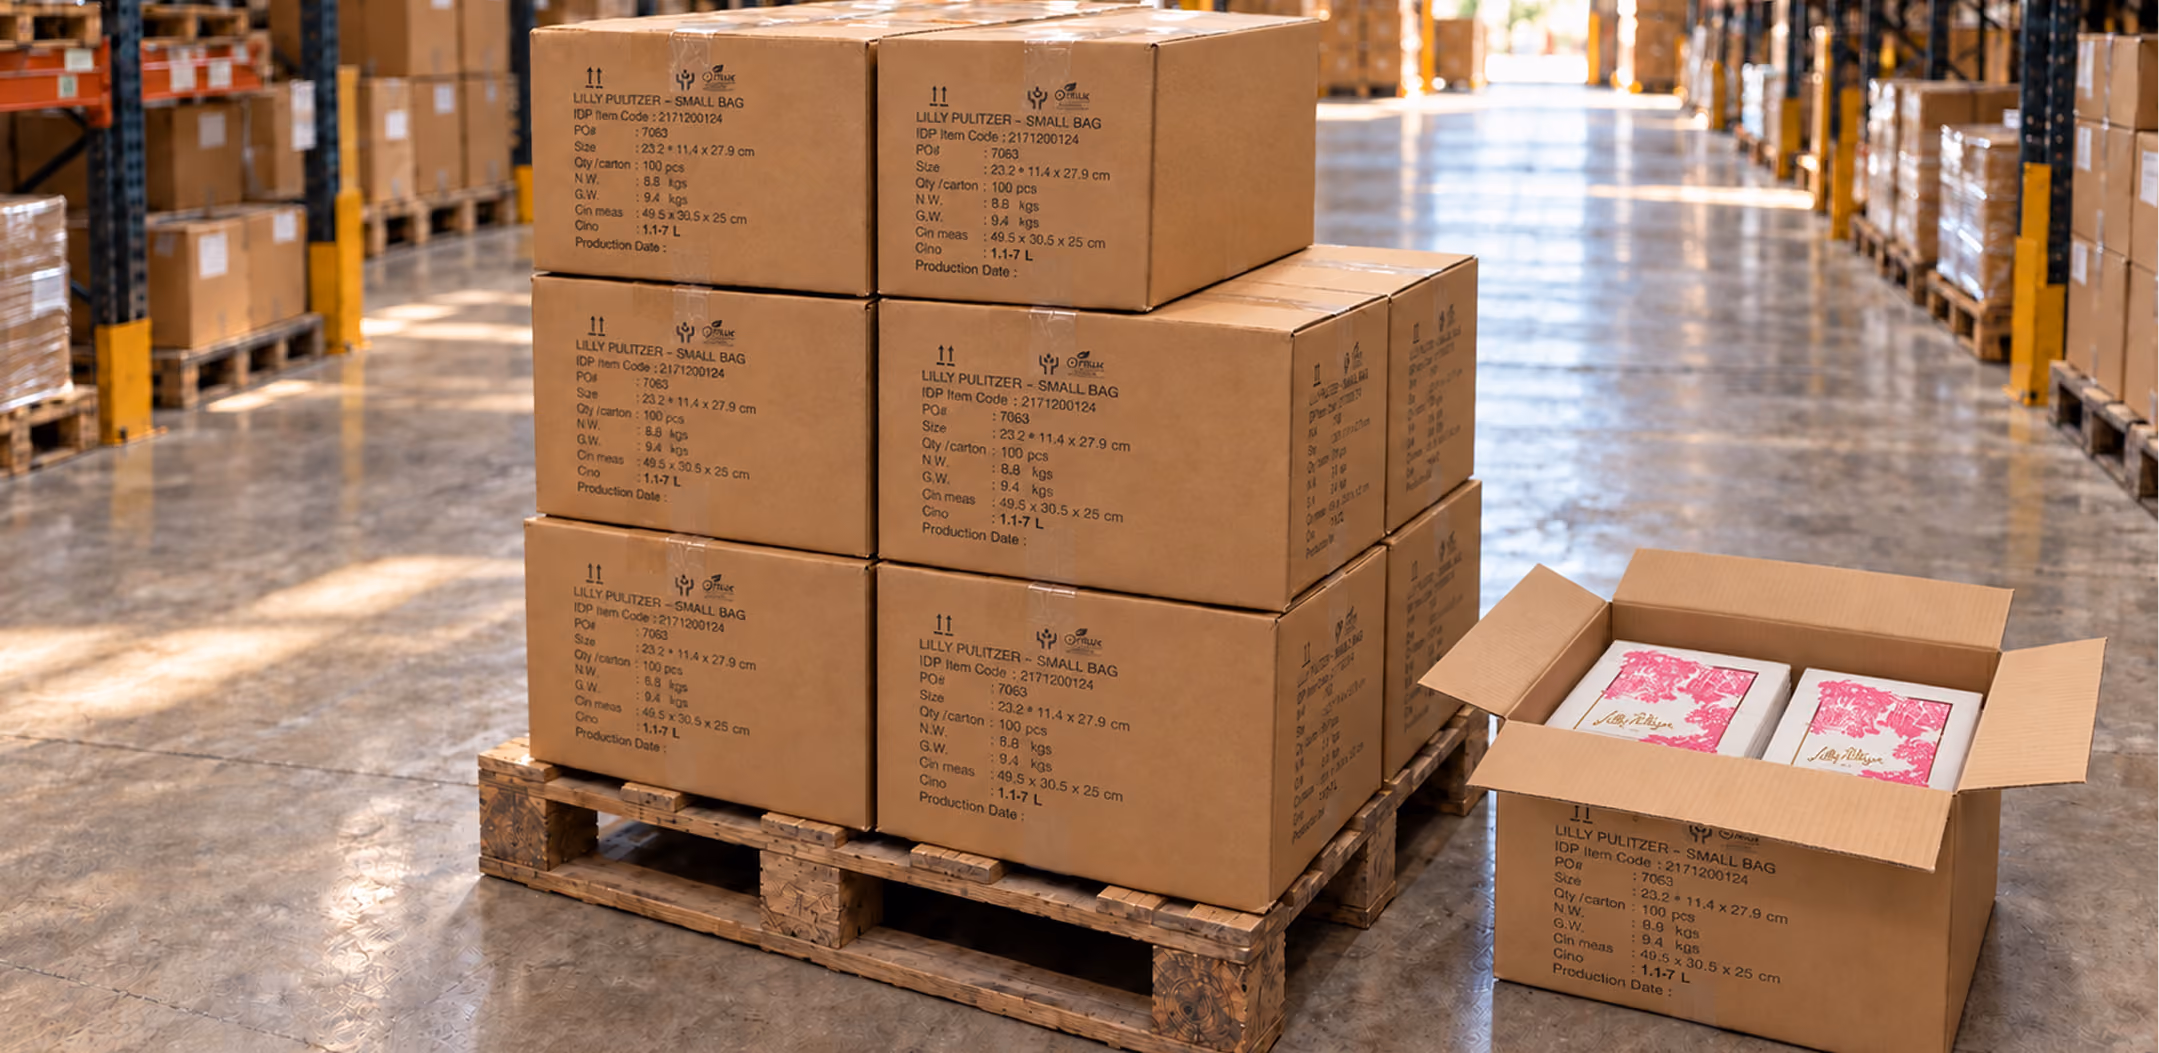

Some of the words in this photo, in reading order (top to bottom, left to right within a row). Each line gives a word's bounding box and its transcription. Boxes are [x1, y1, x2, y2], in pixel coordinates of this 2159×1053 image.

[573, 92, 603, 104] LILLY
[674, 95, 714, 108] SMALL
[718, 96, 744, 109] BAG
[658, 111, 723, 124] 2171200124
[916, 111, 949, 123] LILLY
[951, 111, 1012, 126] PULITZER
[1025, 114, 1069, 128] SMALL
[1072, 116, 1101, 130] BAG
[641, 126, 668, 138] 7063
[916, 127, 937, 139] IDP
[967, 129, 999, 142] Code
[1008, 131, 1079, 145] 2171200124
[991, 147, 1019, 160] 7063
[643, 159, 662, 172] 100
[1028, 166, 1050, 177] 11.4
[1063, 167, 1089, 180] 27.9
[1091, 171, 1110, 181] cm
[992, 181, 1013, 194] 100
[1016, 184, 1037, 195] pcs
[1018, 200, 1039, 214] kgs
[575, 236, 632, 250] Production
[634, 240, 660, 253] Date
[937, 230, 968, 240] meas
[1029, 233, 1054, 246] 30.5
[1068, 235, 1083, 248] 25
[1087, 239, 1105, 249] cm
[915, 258, 978, 275] Production
[982, 264, 1010, 278] Date
[575, 339, 605, 352] LILLY
[608, 341, 663, 357] PULITZER
[676, 347, 716, 362] SMALL
[719, 351, 746, 365] BAG
[659, 362, 725, 378] 2171200124
[643, 377, 669, 390] 7063
[921, 369, 955, 383] LILLY
[958, 372, 1022, 389] PULITZER
[1038, 379, 1086, 395] SMALL
[1088, 384, 1118, 398] BAG
[922, 386, 944, 399] IDP
[975, 391, 1008, 406] Code
[1021, 395, 1096, 413] 2171200124
[1000, 410, 1030, 424] 7063
[922, 419, 946, 433] Size
[1040, 432, 1064, 445] 11.4
[1079, 435, 1107, 450] 27.9
[1111, 441, 1130, 452] cm
[1001, 446, 1023, 459] 100
[1027, 451, 1048, 463] pcs
[1032, 465, 1053, 482] kgs
[577, 480, 633, 498] Production
[636, 488, 660, 502] Date
[1031, 483, 1053, 499] kgs
[944, 493, 976, 505] meas
[1040, 502, 1068, 516] 30.5
[1083, 507, 1100, 520] 25
[1104, 512, 1123, 523] cm
[922, 521, 986, 541] Production
[990, 530, 1019, 545] Date
[573, 586, 603, 599] LILLY
[605, 589, 661, 608] PULITZER
[674, 600, 715, 616] SMALL
[718, 606, 746, 620] BAG
[658, 614, 724, 632] 2171200124
[642, 626, 668, 640] 7063
[643, 660, 661, 673] 100
[919, 638, 953, 653] LILLY
[956, 642, 1021, 663] PULITZER
[1036, 654, 1083, 673] SMALL
[1087, 661, 1118, 677] BAG
[919, 654, 942, 668] IDP
[974, 662, 1006, 678] Code
[1020, 669, 1093, 690] 2171200124
[998, 682, 1028, 698] 7063
[919, 688, 944, 703] Size
[1038, 706, 1062, 720] 11.4
[1077, 713, 1106, 727] 27.9
[1110, 720, 1130, 732] cm
[999, 718, 1021, 733] 100
[1025, 725, 1047, 736] pcs
[1030, 740, 1052, 756] kgs
[1030, 758, 1052, 773] kgs
[942, 763, 975, 777] meas
[1039, 777, 1067, 792] 30.5
[1083, 784, 1099, 798] 25
[1103, 790, 1123, 802] cm
[919, 790, 984, 813] Production
[988, 803, 1017, 820] Date
[1555, 825, 1593, 840] LILLY
[1597, 831, 1668, 854] PULITZER
[1686, 848, 1738, 868] SMALL
[1742, 857, 1776, 874] BAG
[1555, 840, 1579, 854] IDP
[1616, 851, 1651, 868] Code
[1665, 860, 1748, 885] 2171200124
[1641, 871, 1673, 887] 7063
[1642, 904, 1666, 918] 100
[1671, 911, 1695, 923] pcs
[1687, 896, 1714, 910] 11.4
[1730, 904, 1761, 919] 27.9
[1766, 913, 1788, 924] cm
[1578, 939, 1613, 953] meas
[1686, 957, 1717, 972] 30.5
[1734, 966, 1753, 979] 25
[1758, 972, 1780, 984] cm
[1552, 962, 1626, 987] Production
[1630, 978, 1663, 995] Date
